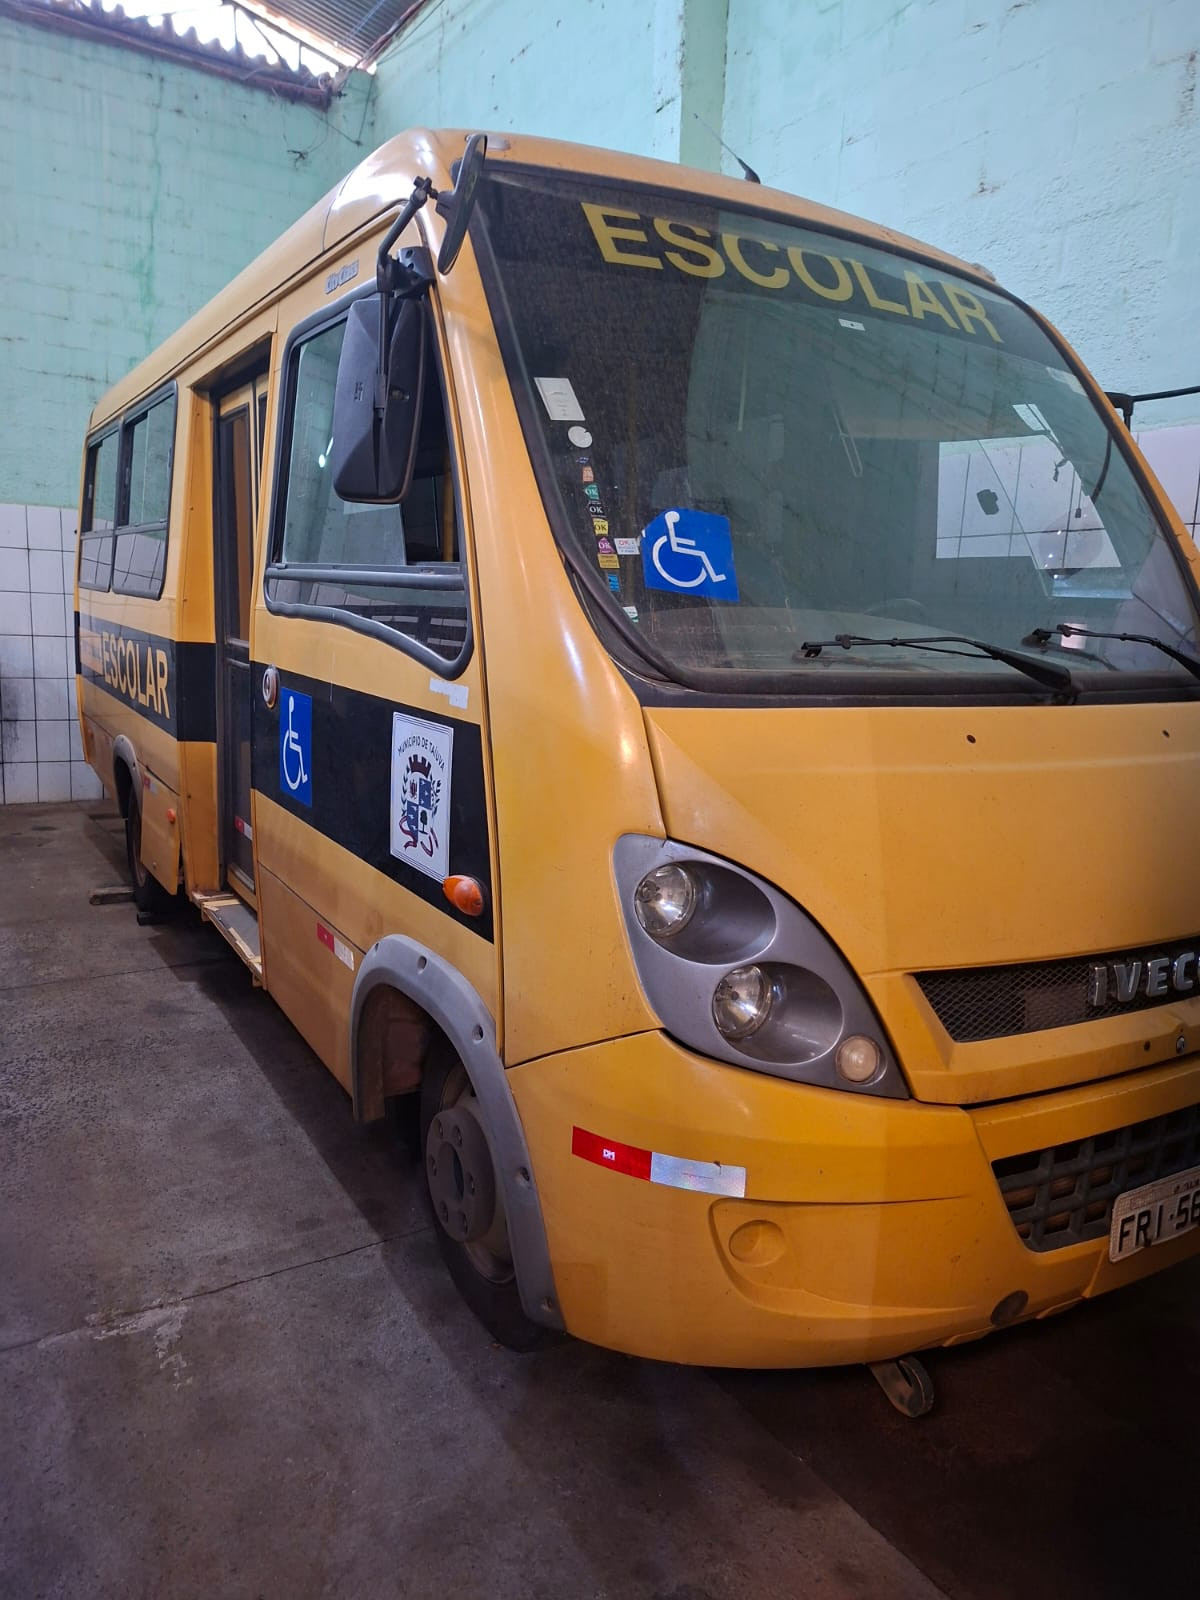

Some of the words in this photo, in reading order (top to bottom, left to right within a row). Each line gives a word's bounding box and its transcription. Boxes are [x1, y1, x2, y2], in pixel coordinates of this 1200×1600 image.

[580, 202, 1005, 343] ESCOLAR
[595, 523, 607, 531] OK
[103, 632, 170, 719] ESCOLAR
[422, 737, 429, 750] DE
[1090, 951, 1200, 1007] IVEC
